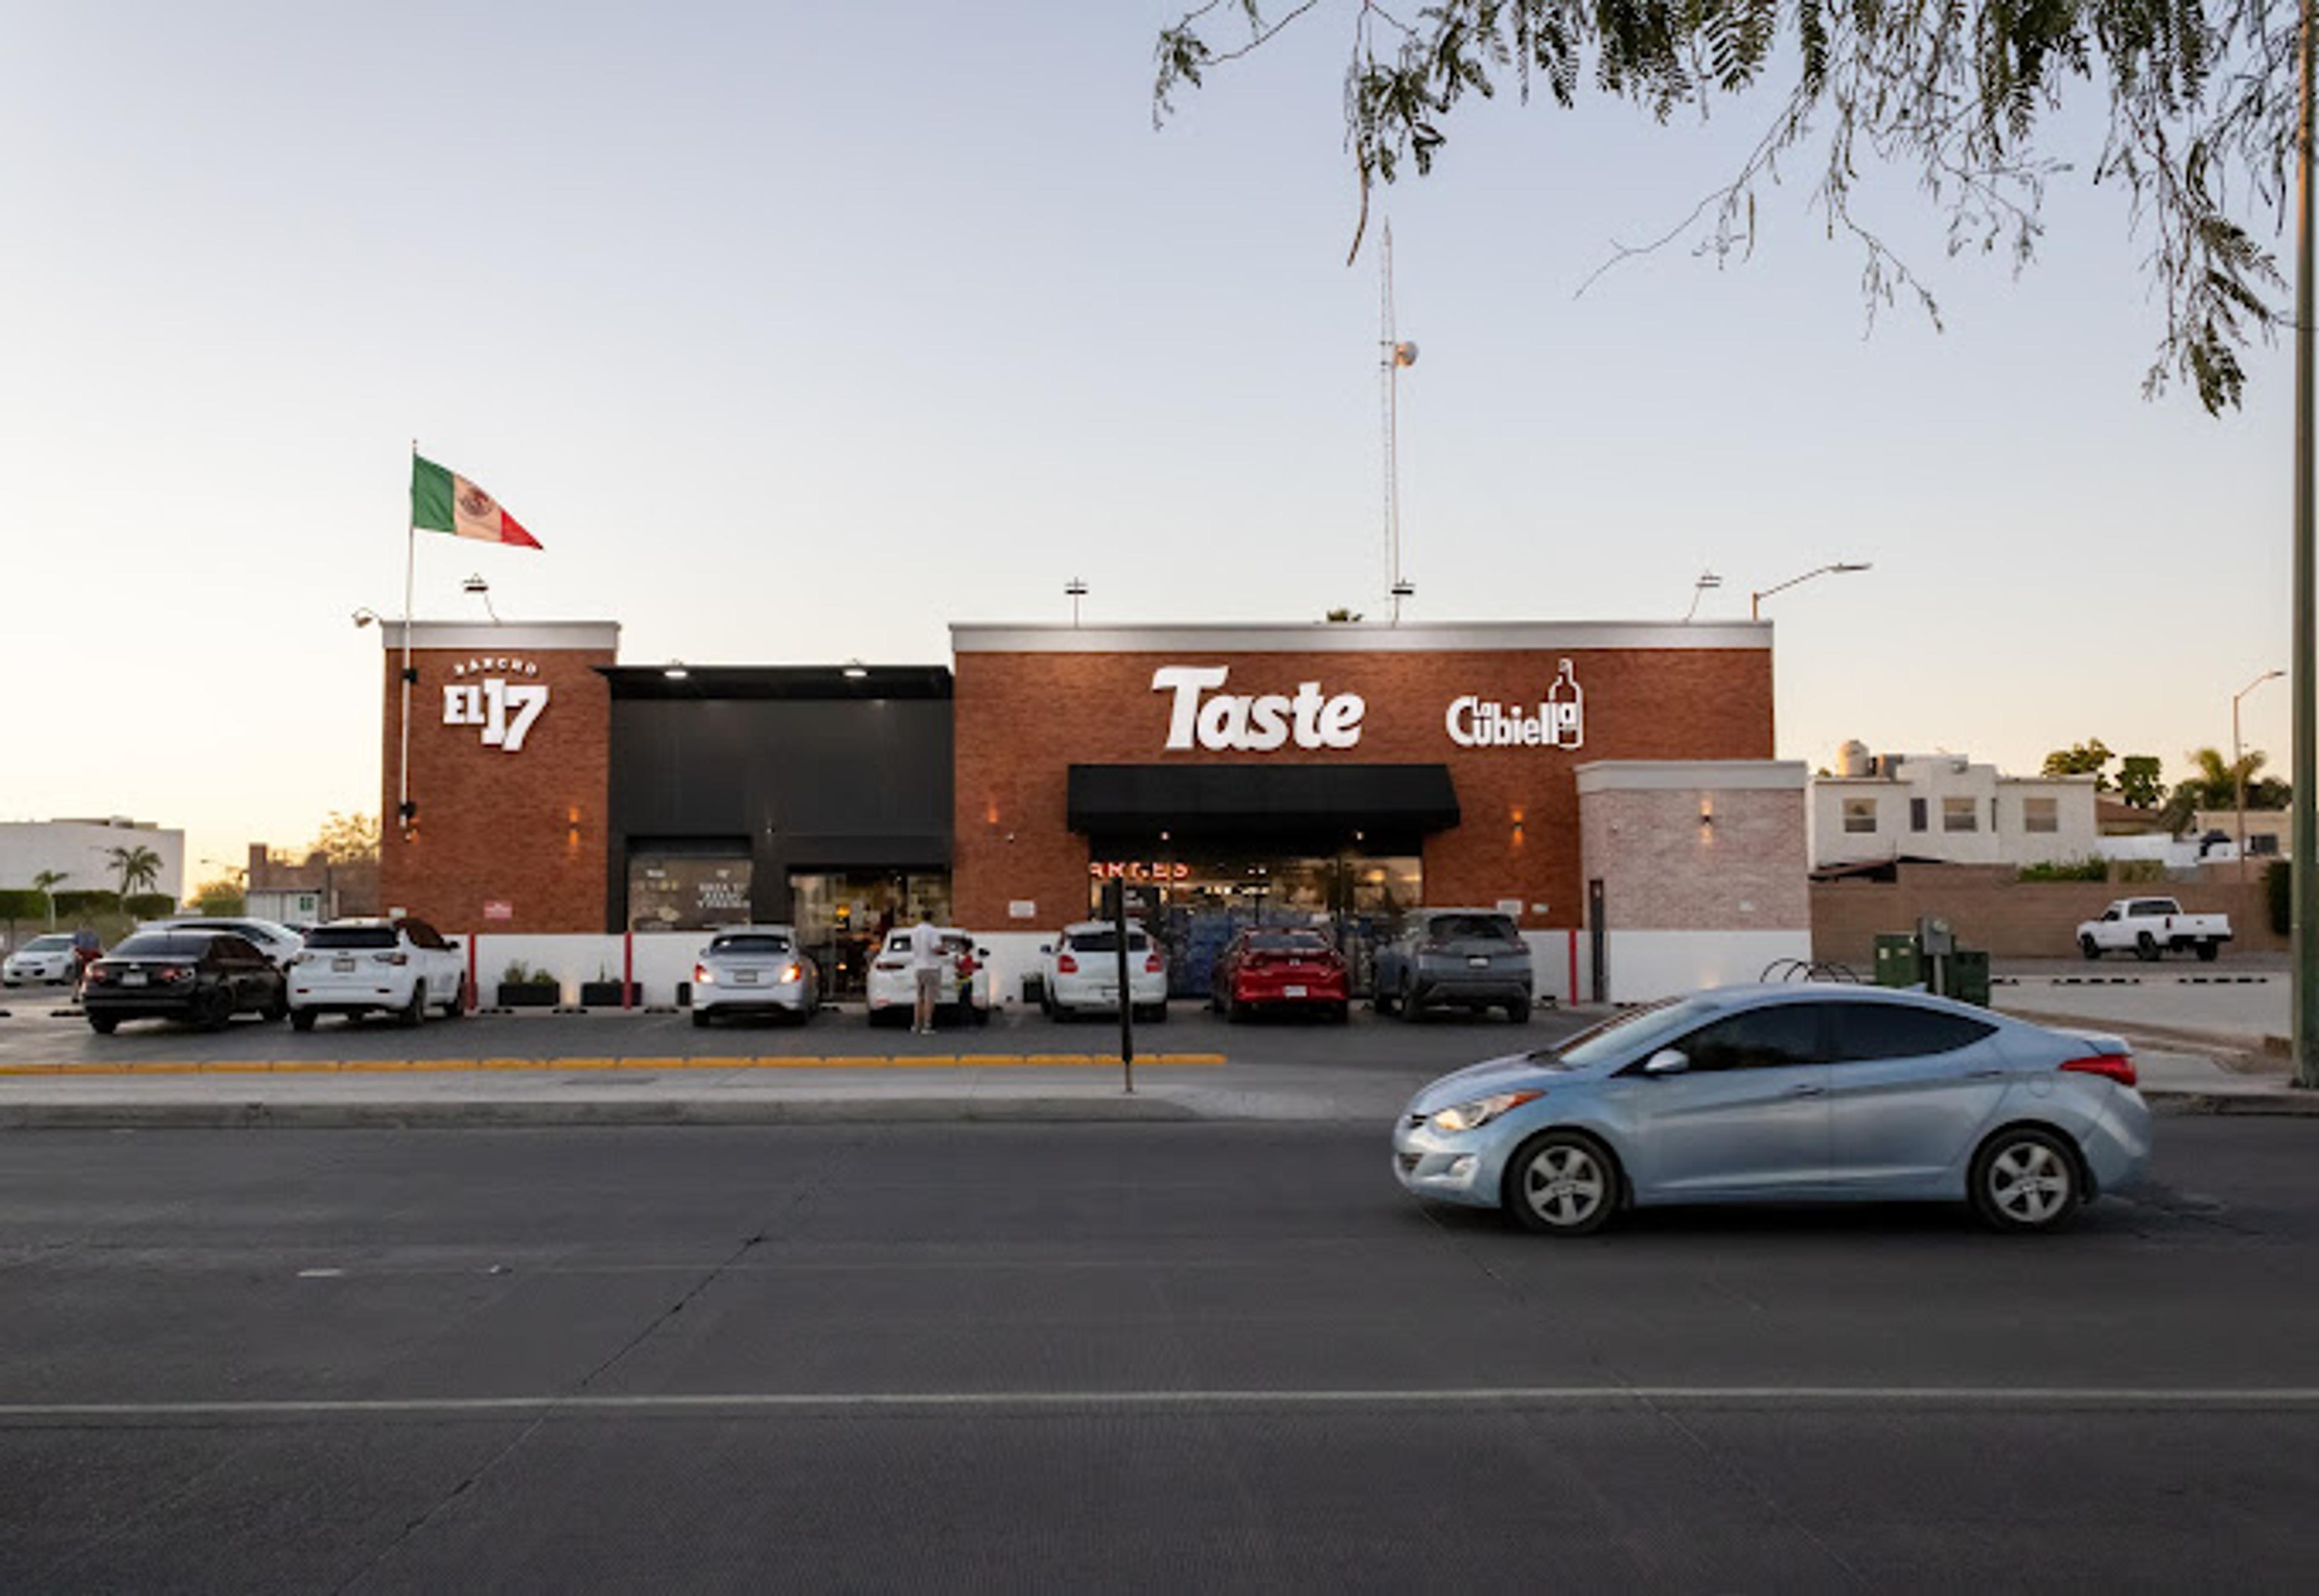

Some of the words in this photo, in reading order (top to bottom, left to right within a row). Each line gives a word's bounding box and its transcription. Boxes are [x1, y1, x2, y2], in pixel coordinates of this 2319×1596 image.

[454, 657, 537, 676] RANCHO
[481, 678, 549, 751] 17
[1152, 664, 1366, 751] Taste
